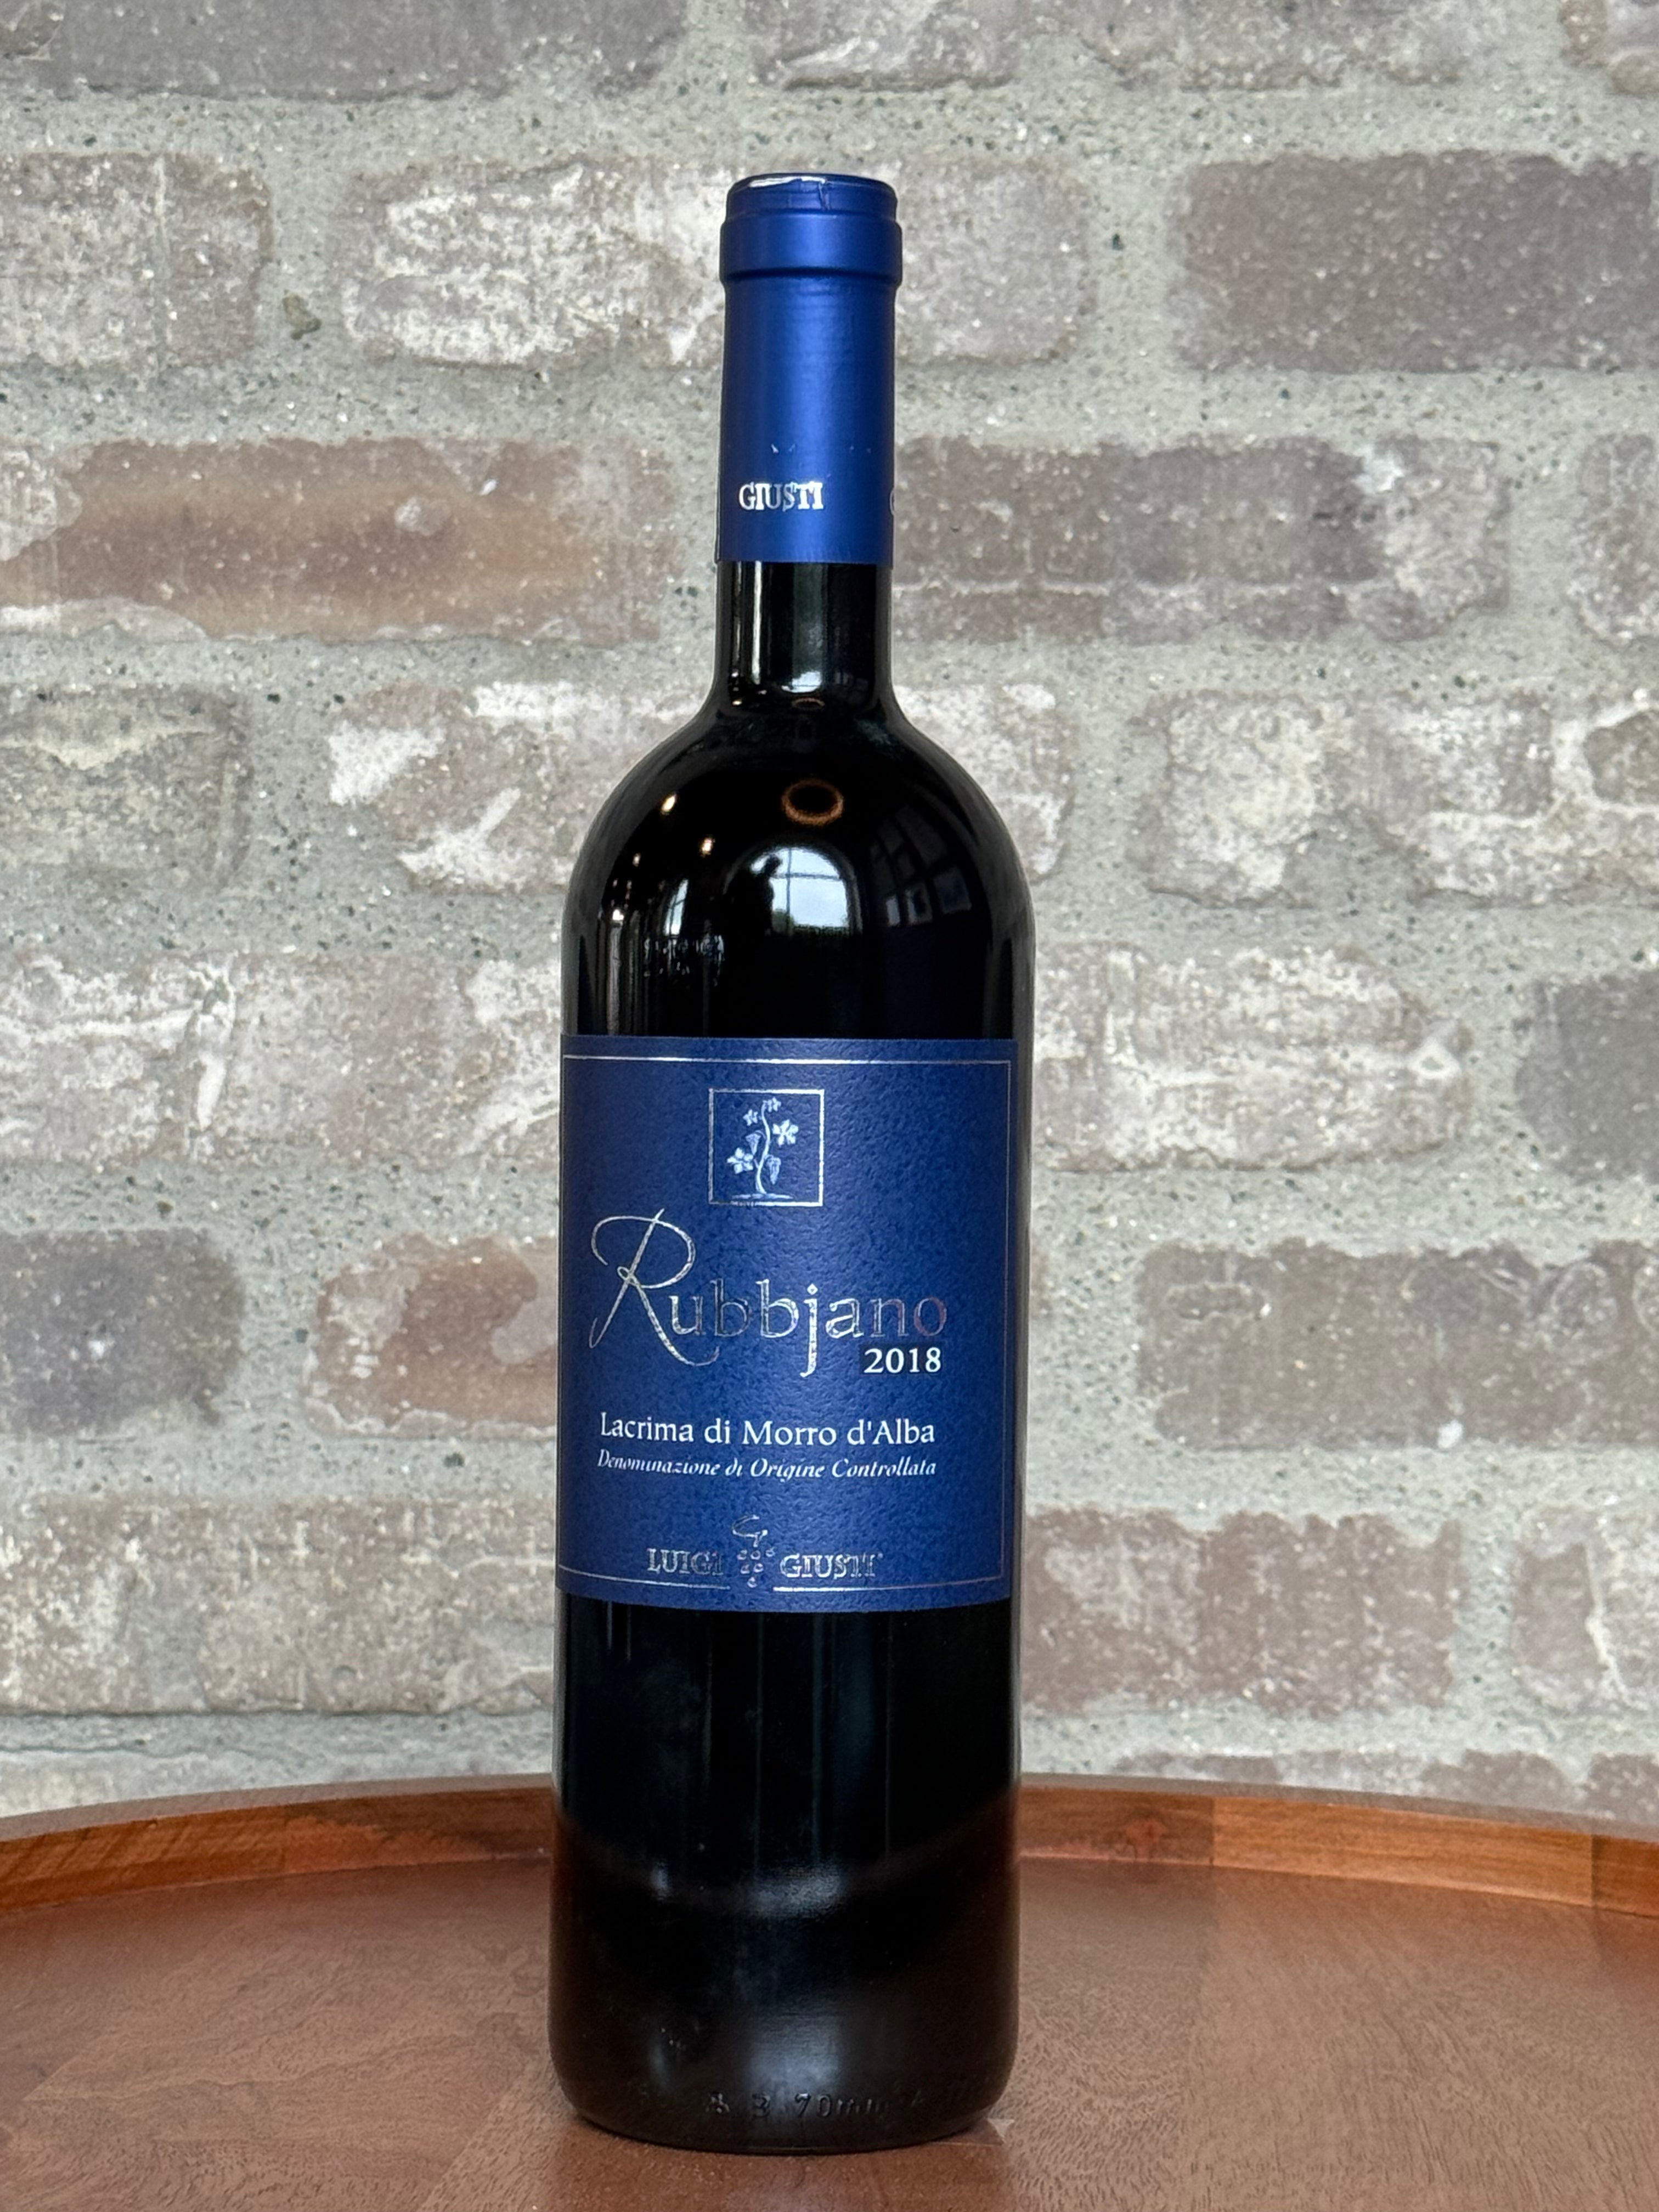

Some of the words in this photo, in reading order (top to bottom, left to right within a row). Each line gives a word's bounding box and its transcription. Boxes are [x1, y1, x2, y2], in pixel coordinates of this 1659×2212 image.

[738, 481, 824, 512] GIUSTI
[589, 1209, 947, 1377] Rubbjano
[864, 1347, 942, 1375] 2018
[600, 1412, 694, 1442] Lacrima
[704, 1418, 731, 1444] di
[742, 1420, 837, 1446] Morro
[847, 1418, 935, 1446] d'Alba
[597, 1448, 721, 1476] Denominazione
[724, 1457, 743, 1477] di
[750, 1457, 826, 1483] Origine
[831, 1455, 937, 1477] Controllata
[647, 1548, 724, 1575] LUIGI
[779, 1552, 878, 1579] GIUSTI
